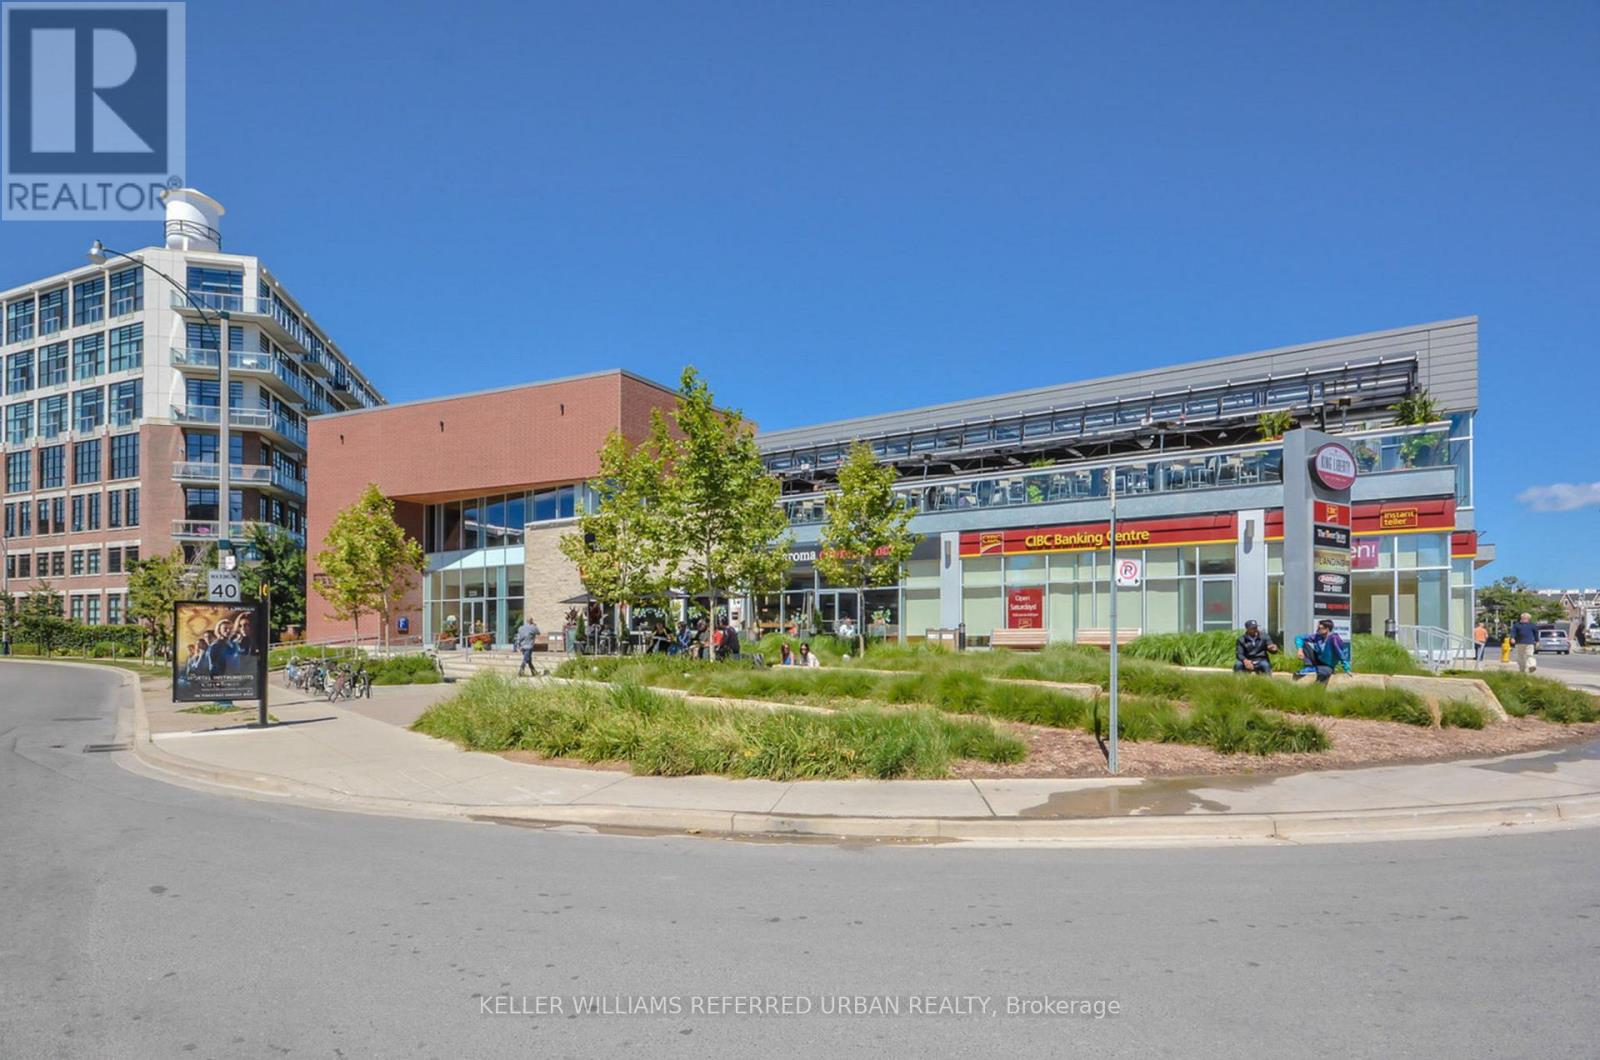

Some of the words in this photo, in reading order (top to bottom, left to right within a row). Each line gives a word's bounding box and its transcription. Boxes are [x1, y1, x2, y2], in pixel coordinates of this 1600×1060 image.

[1383, 511, 1415, 519] instant
[1383, 518, 1407, 526] teller
[1025, 535, 1053, 548] CIBC
[1054, 532, 1104, 547] Banking
[1106, 529, 1150, 542] Centre
[211, 584, 237, 599] 40
